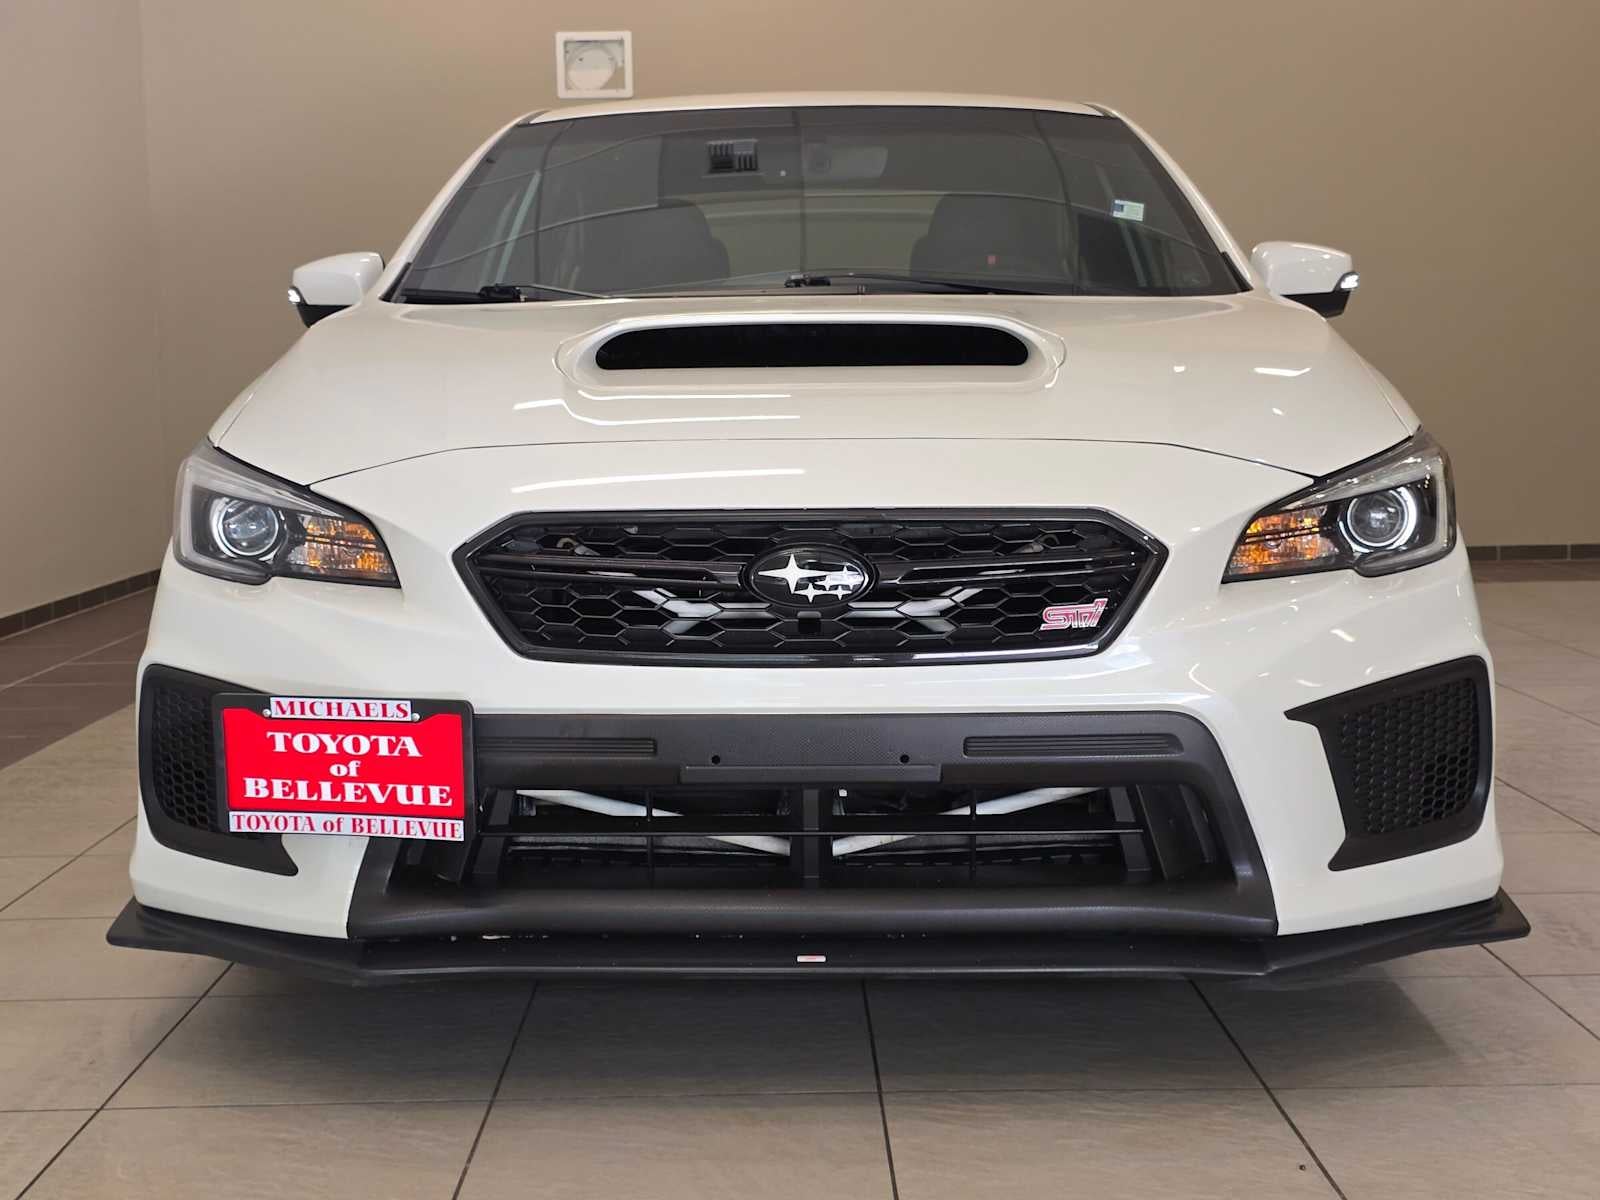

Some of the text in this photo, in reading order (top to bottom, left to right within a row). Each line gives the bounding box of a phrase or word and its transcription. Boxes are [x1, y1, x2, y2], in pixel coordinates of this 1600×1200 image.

[273, 700, 409, 718] MICHAELS
[266, 731, 423, 757] TOYOTA
[329, 760, 361, 777] of
[243, 777, 453, 807] BELLEVUE
[232, 814, 462, 839] TOYOTA of BELLEVUE
